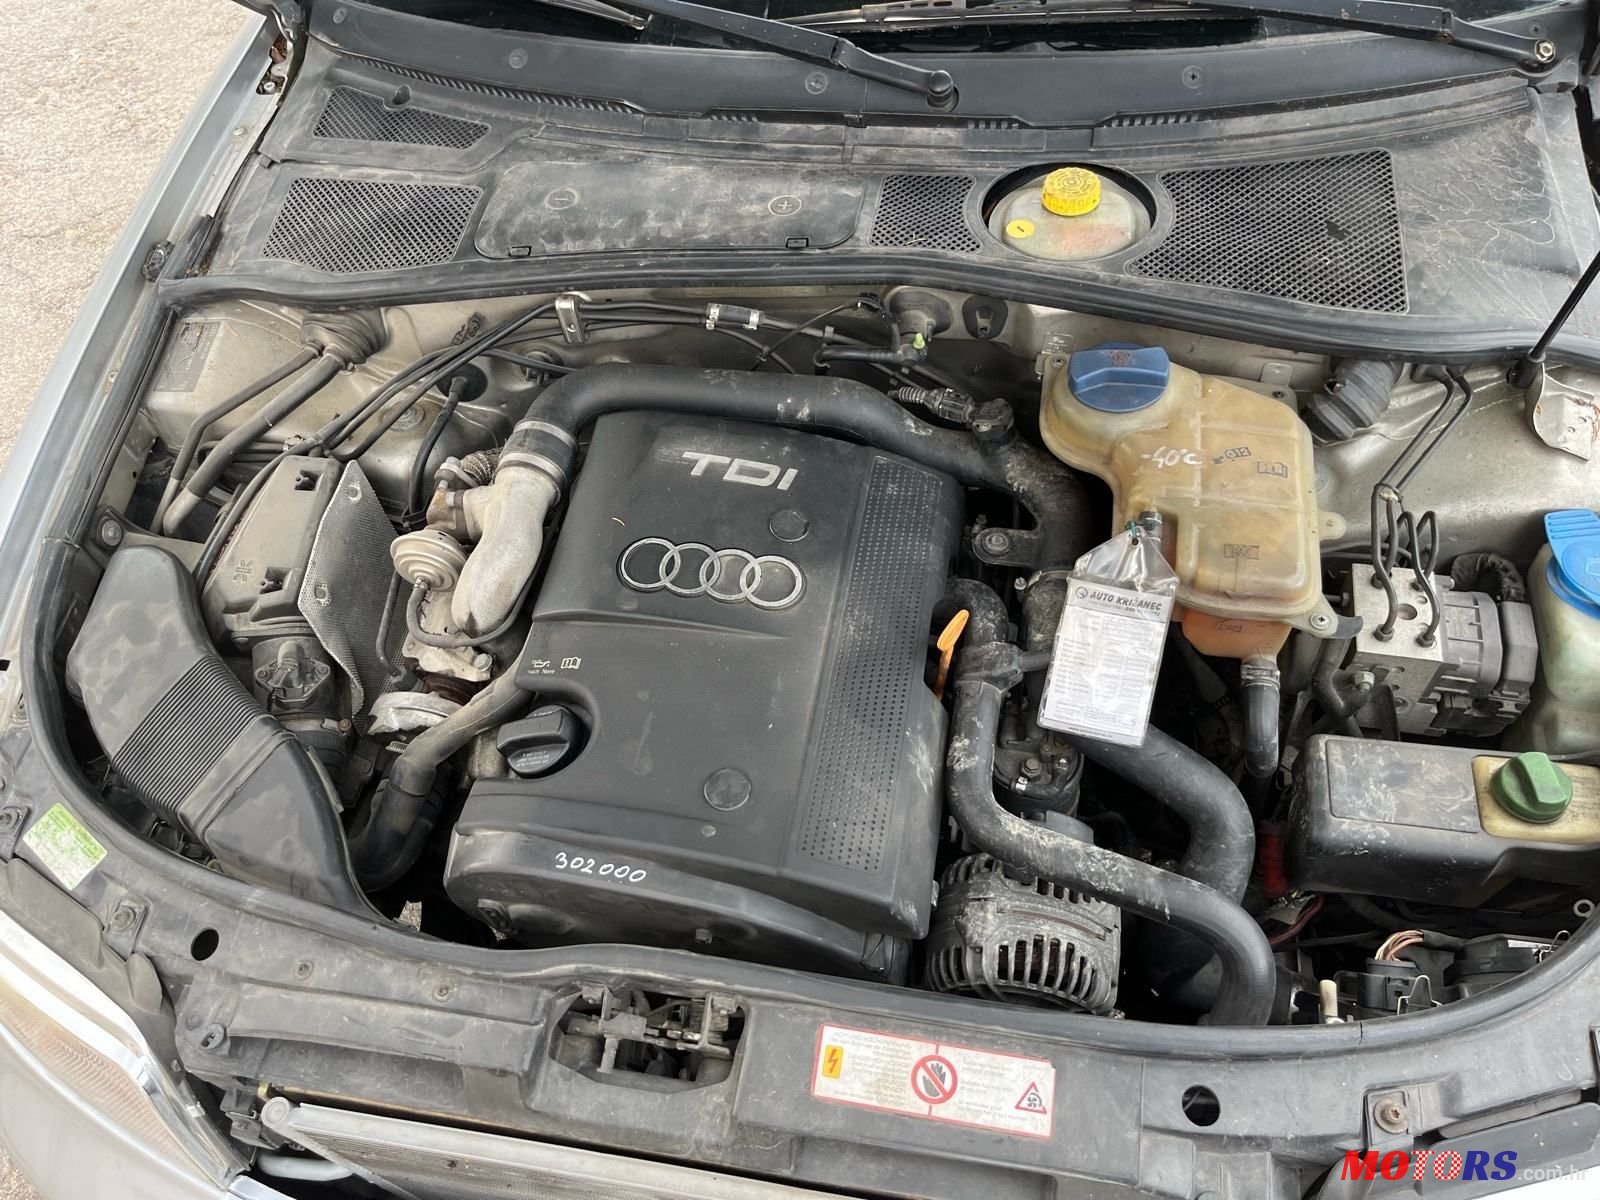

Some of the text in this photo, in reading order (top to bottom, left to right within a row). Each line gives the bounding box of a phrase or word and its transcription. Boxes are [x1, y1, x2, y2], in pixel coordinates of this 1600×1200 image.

[682, 451, 799, 491] TDI
[1090, 591, 1114, 602] AUTO
[555, 852, 647, 882] 302000
